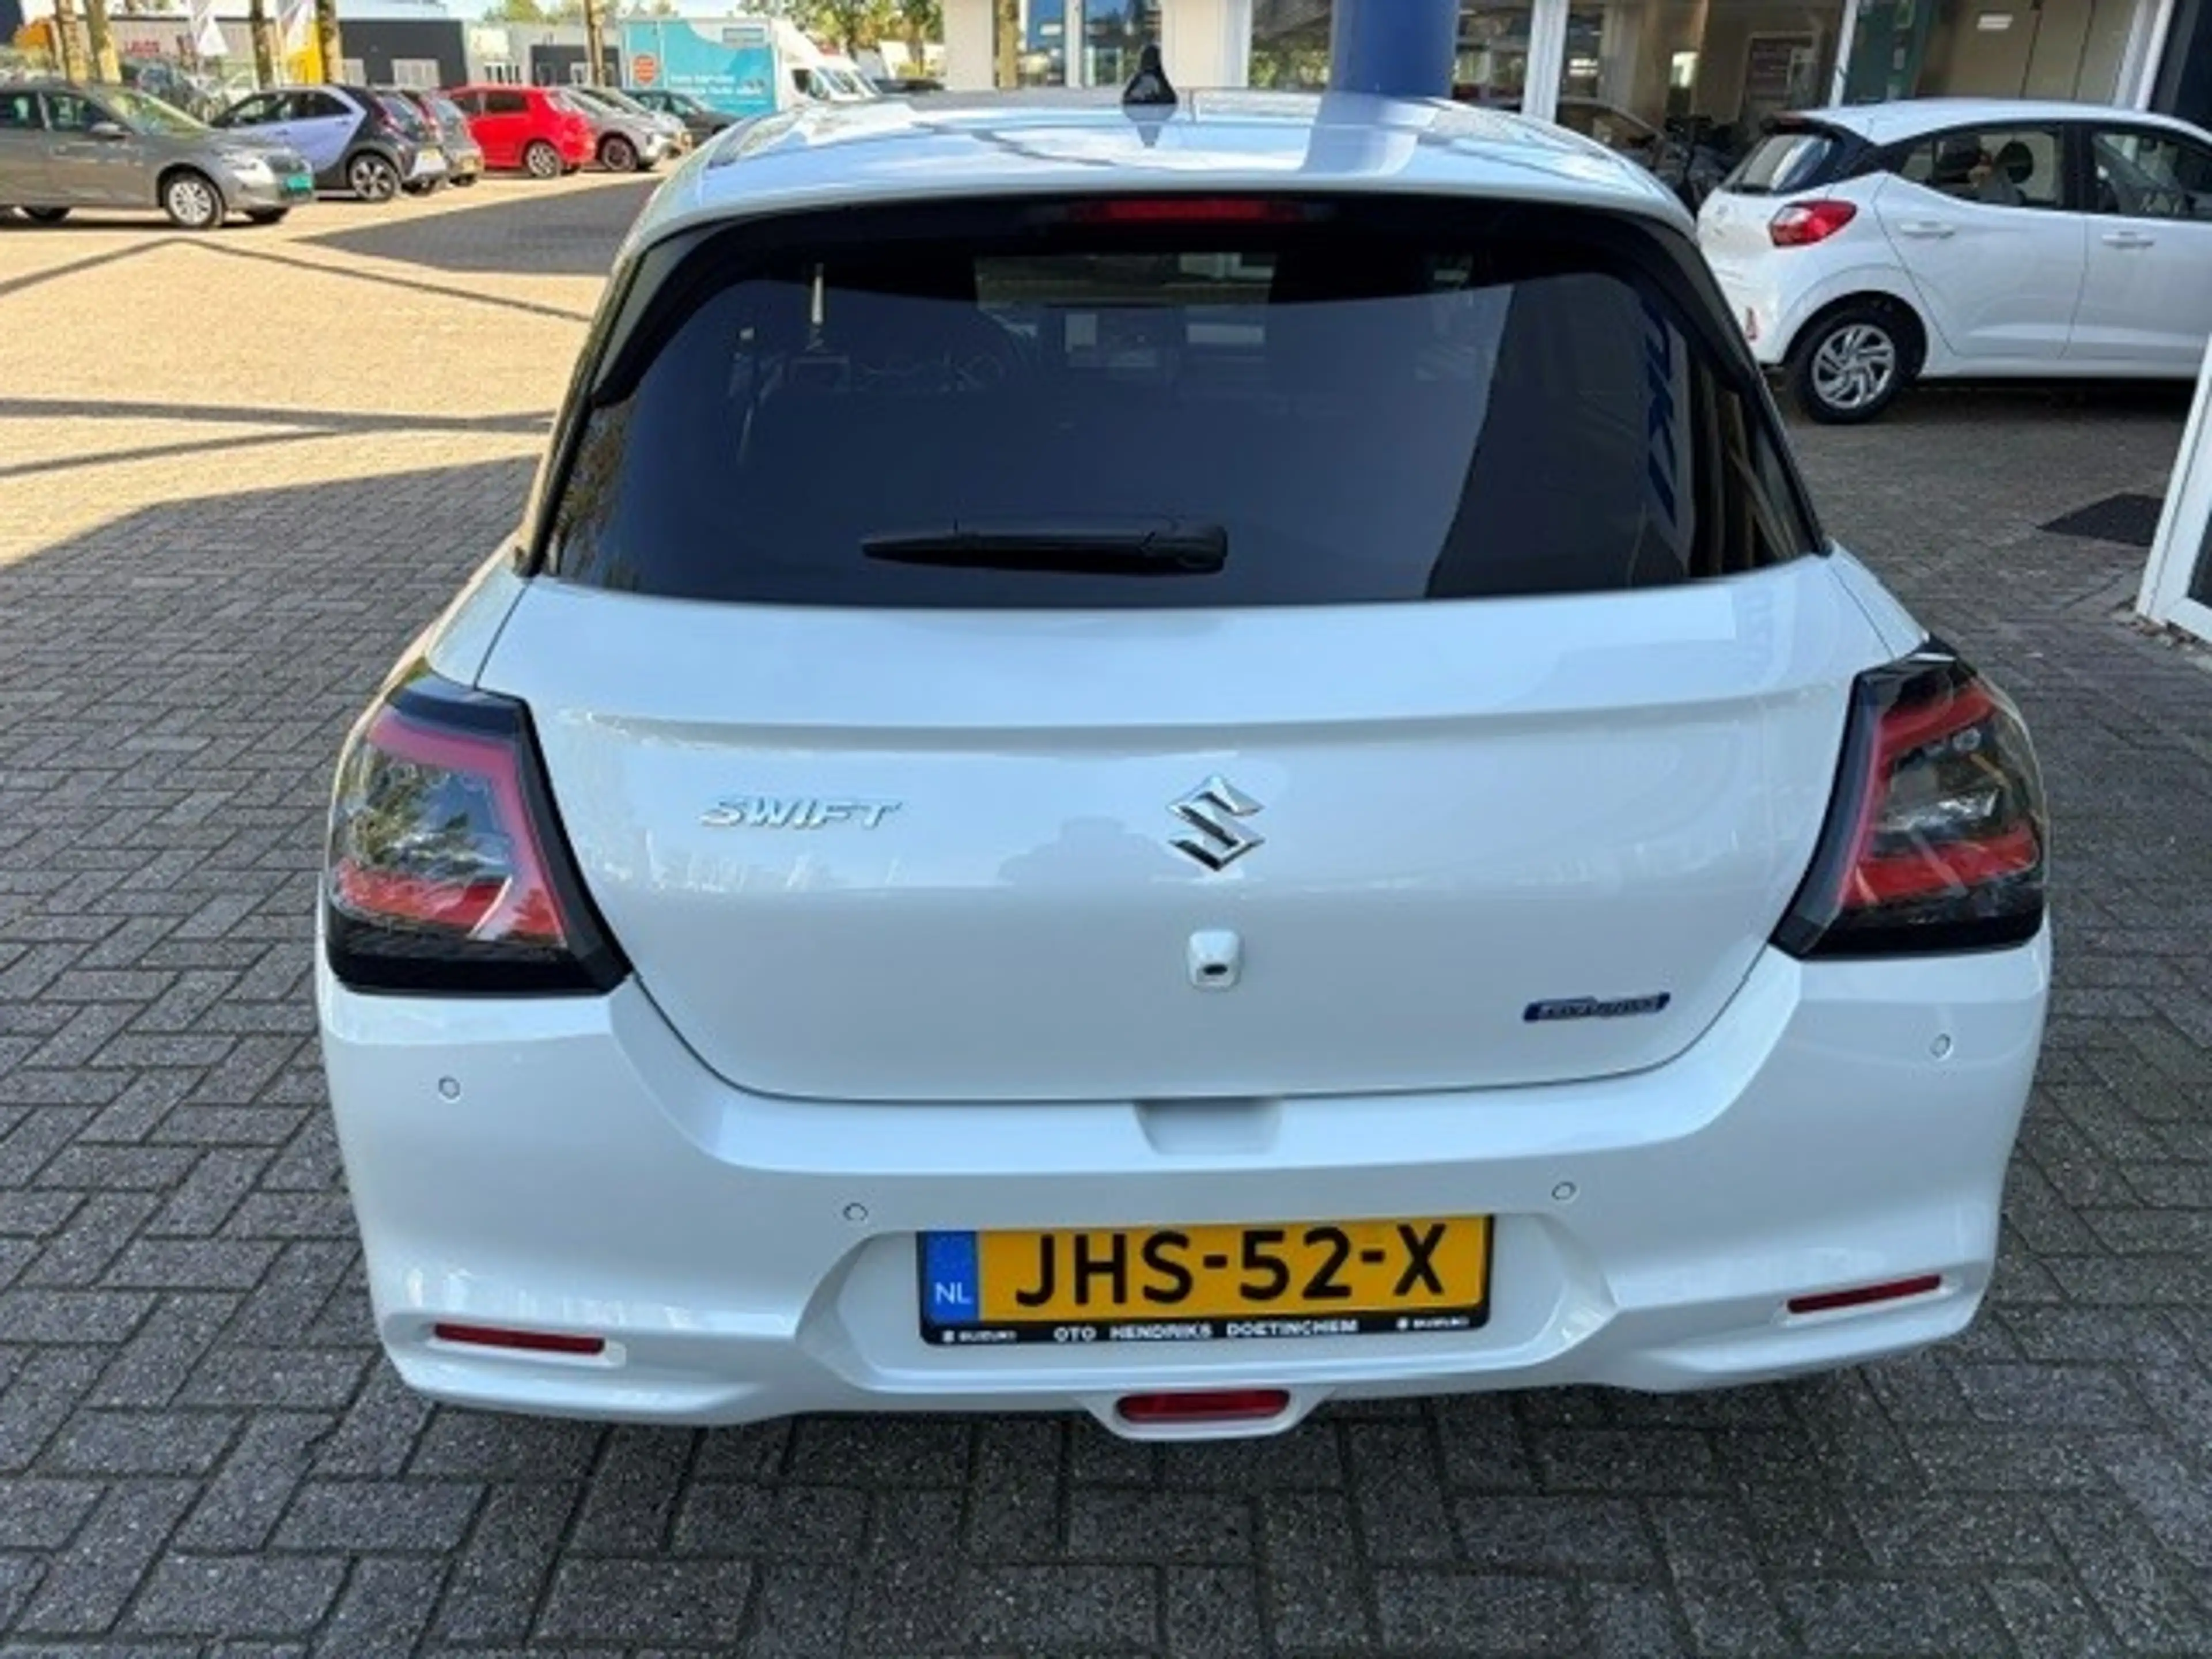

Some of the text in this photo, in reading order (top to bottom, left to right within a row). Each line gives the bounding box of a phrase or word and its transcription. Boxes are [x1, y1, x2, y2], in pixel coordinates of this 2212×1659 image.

[699, 797, 903, 830] SWIFT
[1015, 1223, 1446, 1307] JHS-52-X
[935, 1281, 974, 1305] NL
[1054, 1325, 1097, 1343] OTO
[1109, 1321, 1213, 1340] HENDRIKS
